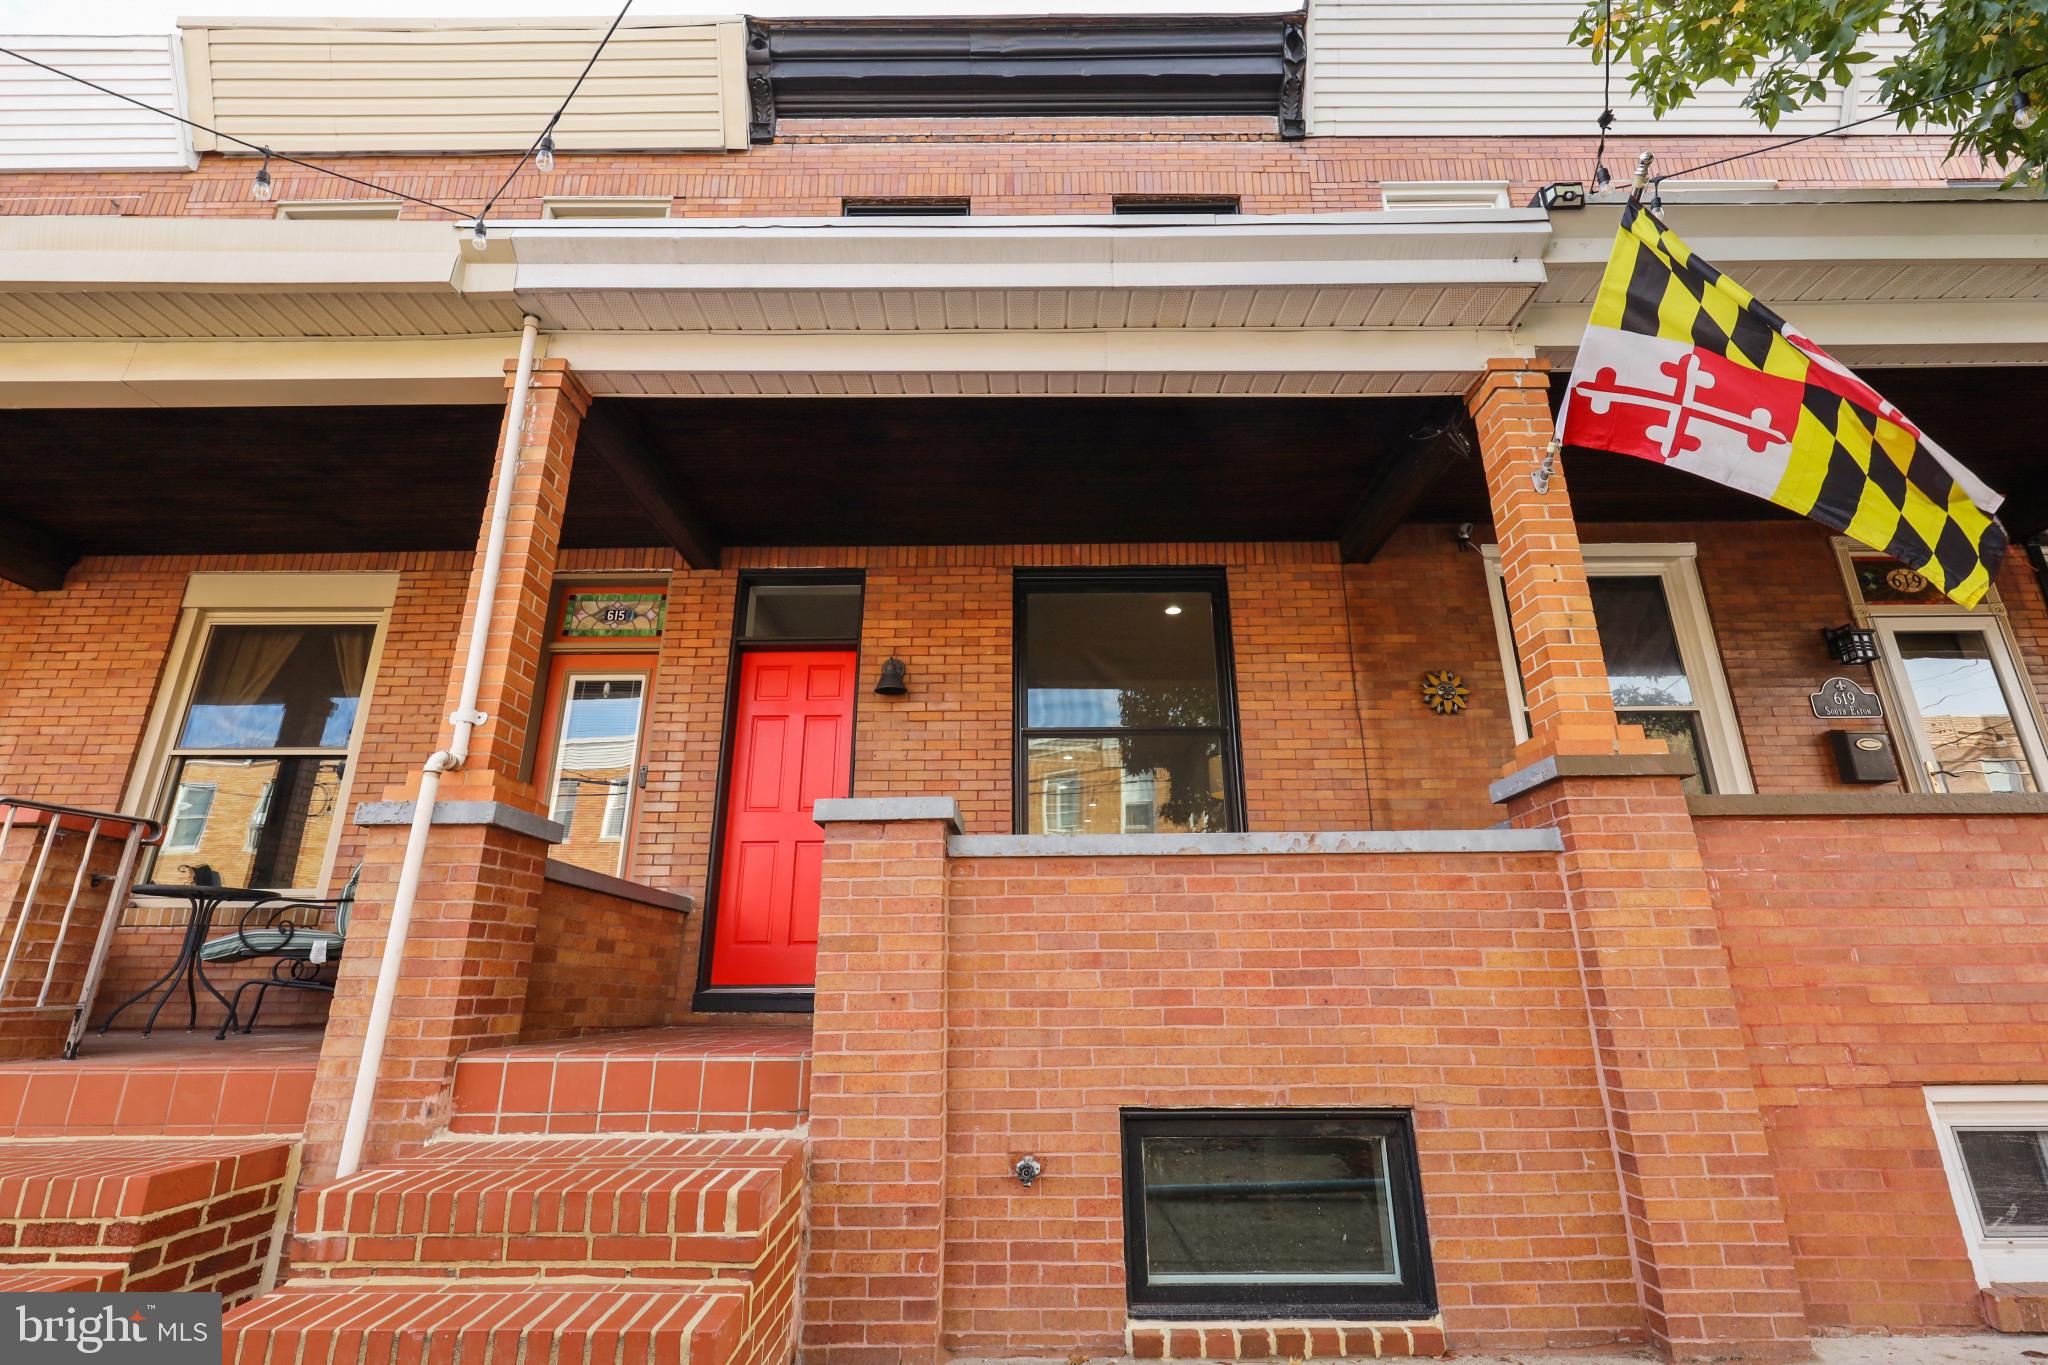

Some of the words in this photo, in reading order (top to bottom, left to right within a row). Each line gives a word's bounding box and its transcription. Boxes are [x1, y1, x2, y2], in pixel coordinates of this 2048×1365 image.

[1892, 573, 1922, 588] 619
[607, 610, 625, 621] 615
[1833, 691, 1856, 705] 619
